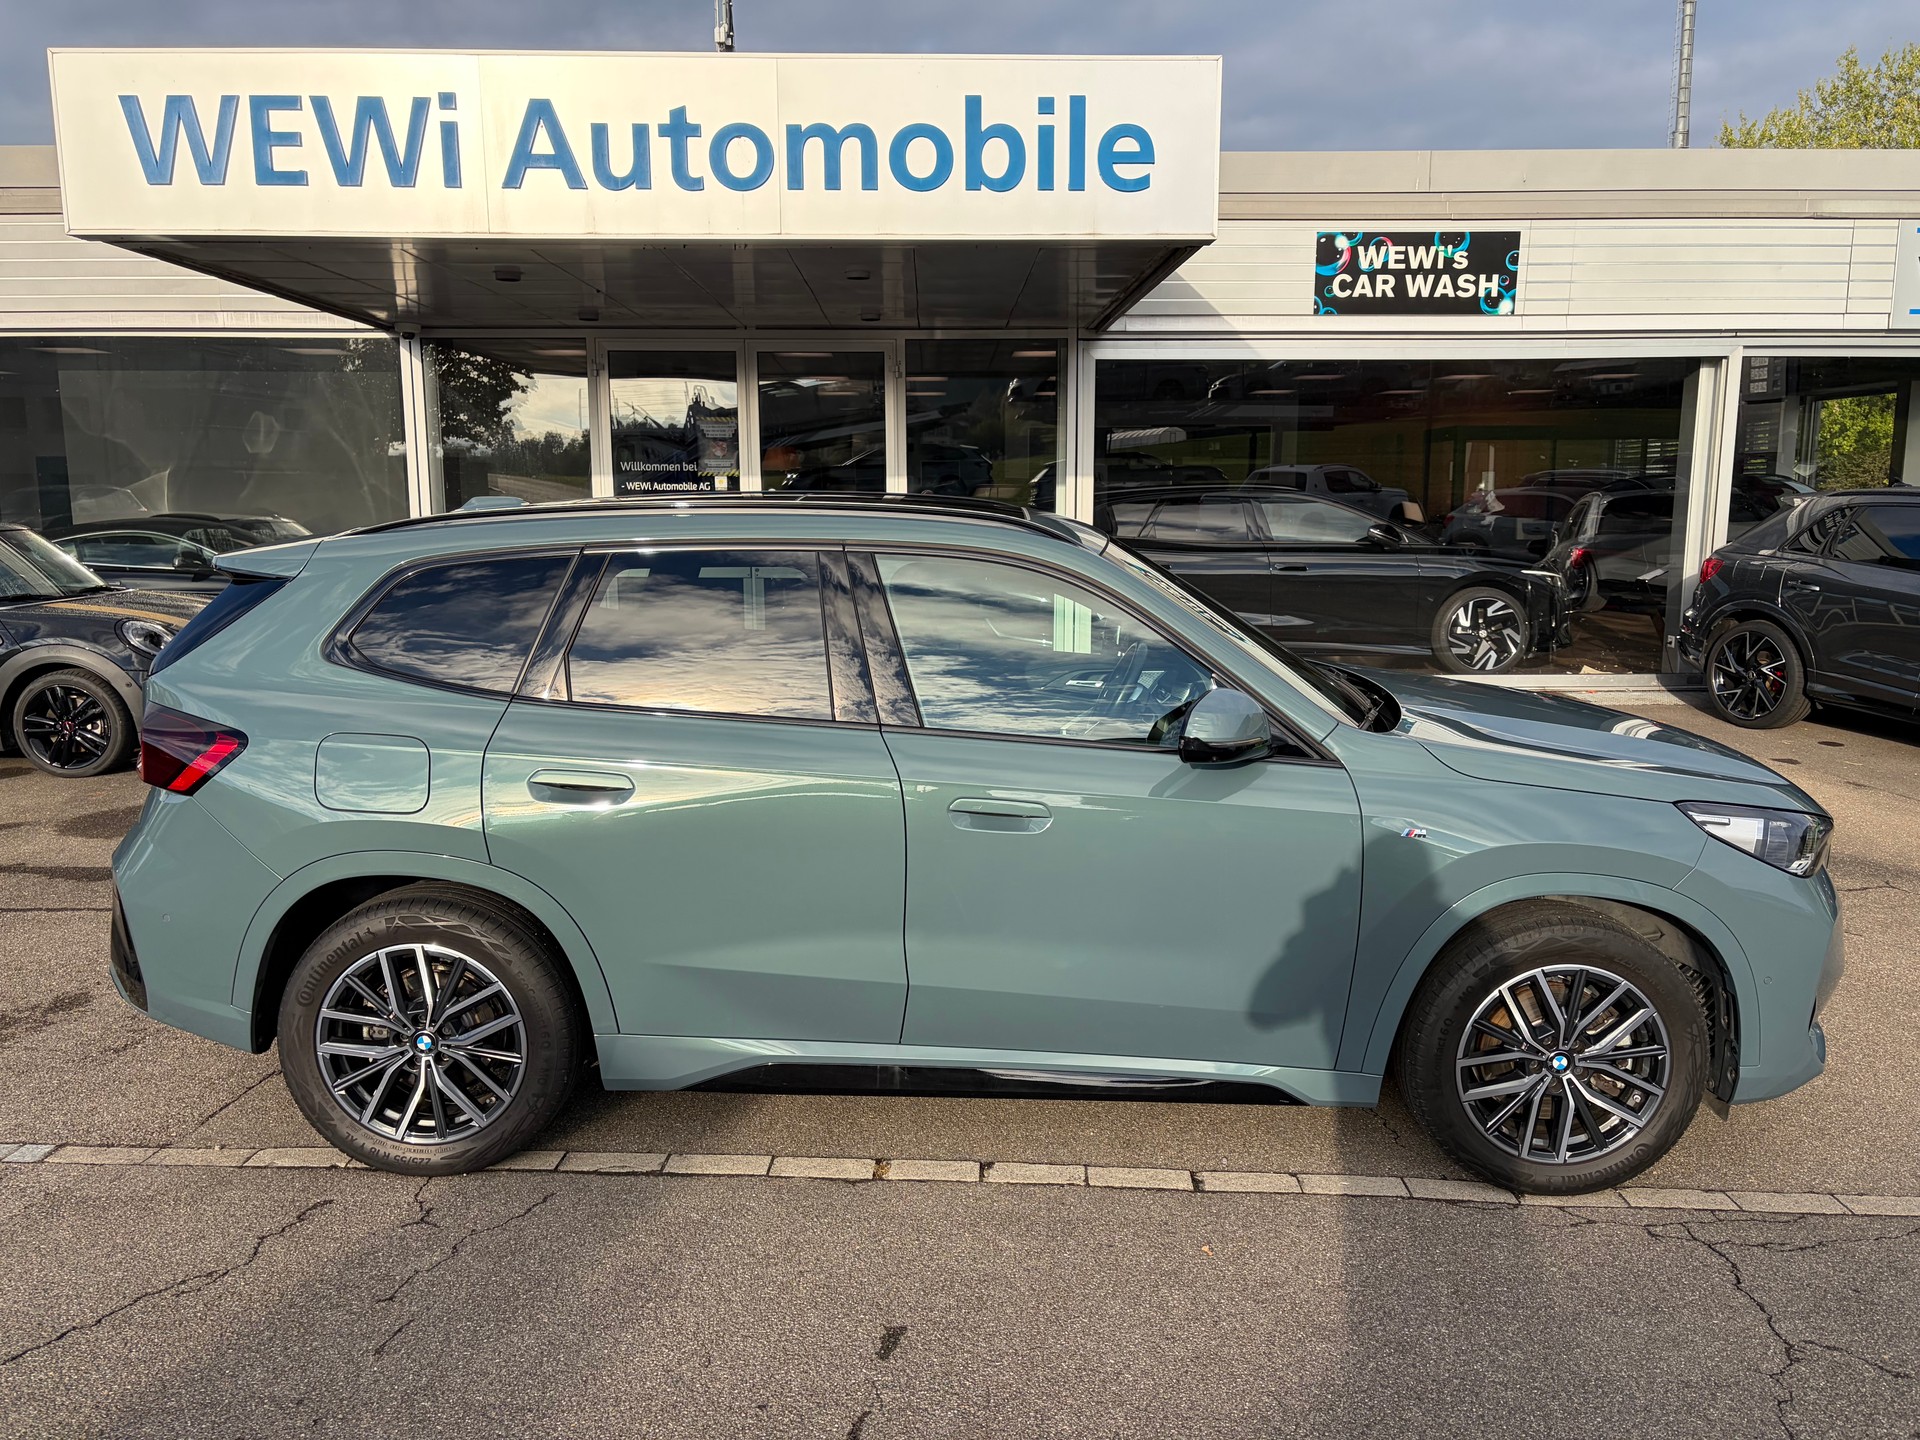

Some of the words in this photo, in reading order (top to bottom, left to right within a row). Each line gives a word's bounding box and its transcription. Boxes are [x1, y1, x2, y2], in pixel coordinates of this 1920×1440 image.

[117, 92, 462, 188] WEWi
[502, 94, 1156, 193] Automobile
[1357, 244, 1469, 270] WEWi's
[1332, 274, 1396, 298] CAR
[1405, 274, 1500, 298] WASH
[620, 461, 680, 472] Willkommen
[682, 461, 698, 472] bei
[626, 481, 652, 491] WEWi
[652, 481, 698, 491] Automobile
[698, 482, 711, 491] AG
[296, 931, 365, 1007] Continental
[370, 1146, 381, 1157] 18
[382, 1151, 391, 1160] R
[393, 1155, 432, 1165] 225/55
[1560, 1143, 1653, 1186] Continental
